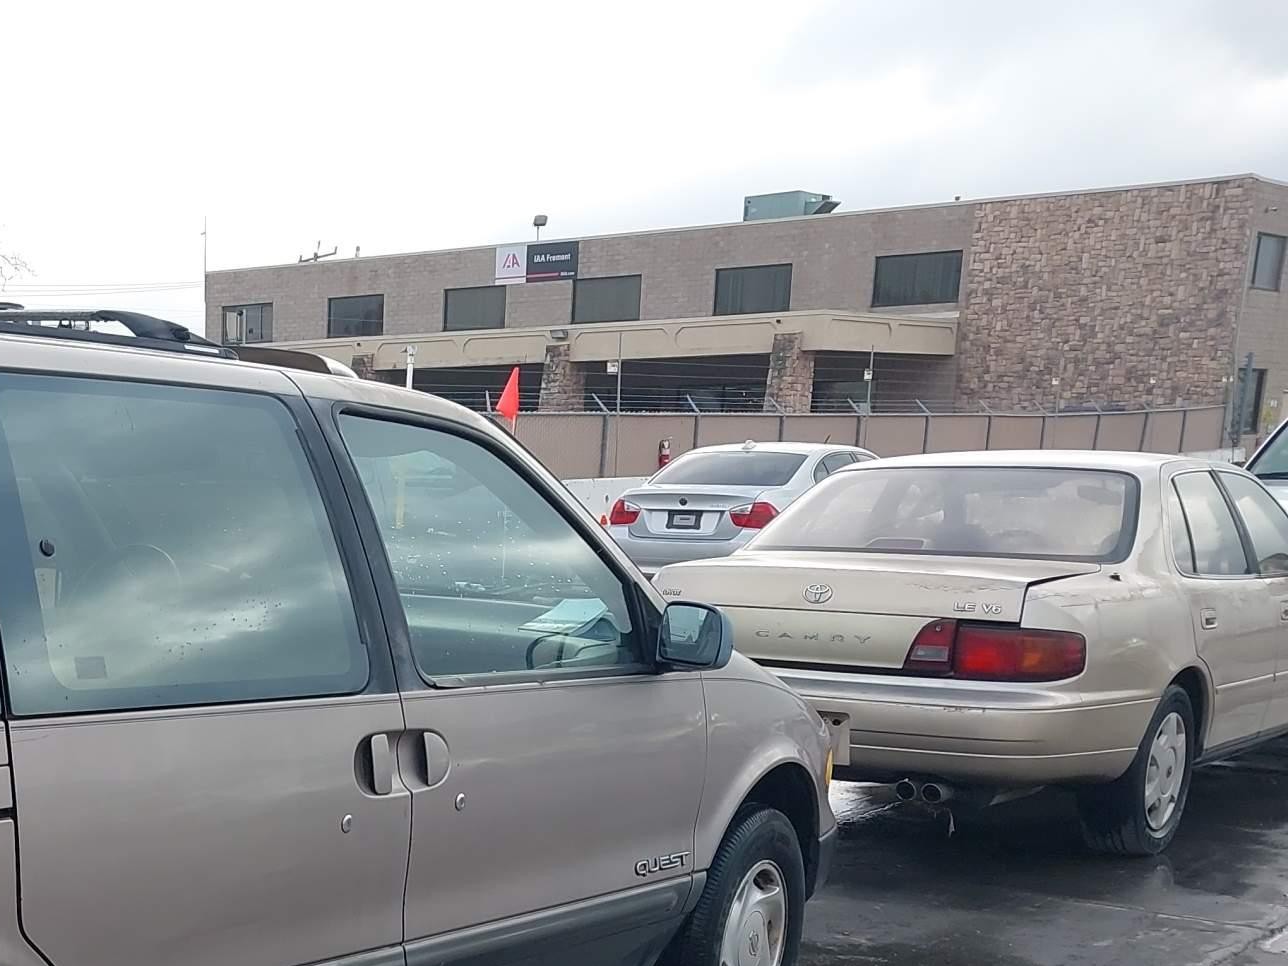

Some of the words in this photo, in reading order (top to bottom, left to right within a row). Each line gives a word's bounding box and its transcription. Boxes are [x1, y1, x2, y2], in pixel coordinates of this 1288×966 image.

[533, 254, 545, 263] IAA
[547, 253, 571, 262] Fremont
[953, 602, 976, 612] LE
[982, 603, 1002, 614] V6
[755, 630, 871, 644] CAMRY
[634, 851, 691, 877] QUEST
